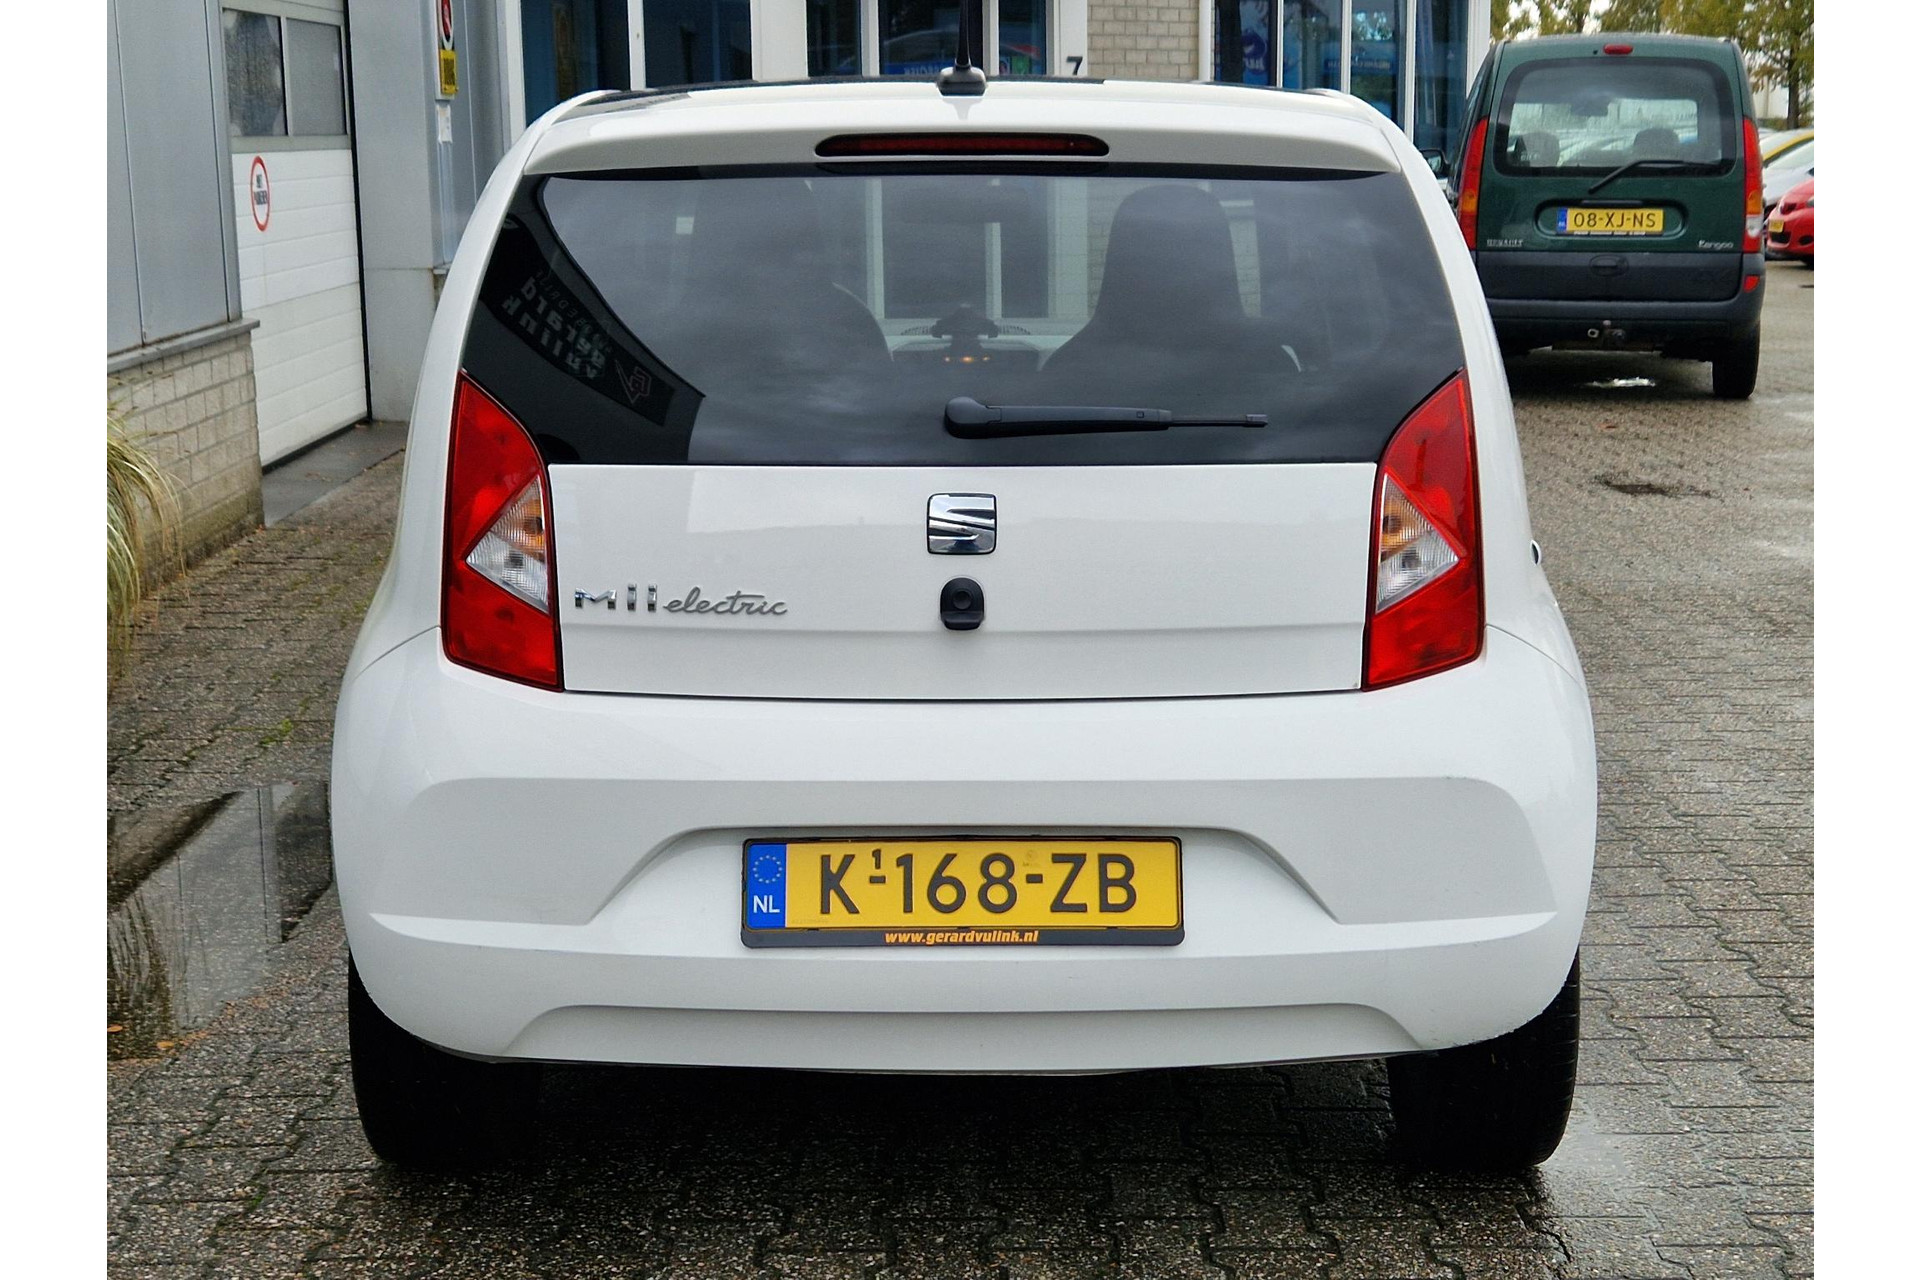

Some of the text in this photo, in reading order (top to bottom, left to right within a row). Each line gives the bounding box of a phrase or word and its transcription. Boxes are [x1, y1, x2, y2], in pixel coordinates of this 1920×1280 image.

[1066, 56, 1083, 75] 7
[1573, 212, 1656, 228] 08-XJ-NS
[663, 586, 788, 616] electric
[753, 894, 779, 914] NL
[885, 930, 1039, 946] www.gerardvulink.nl
